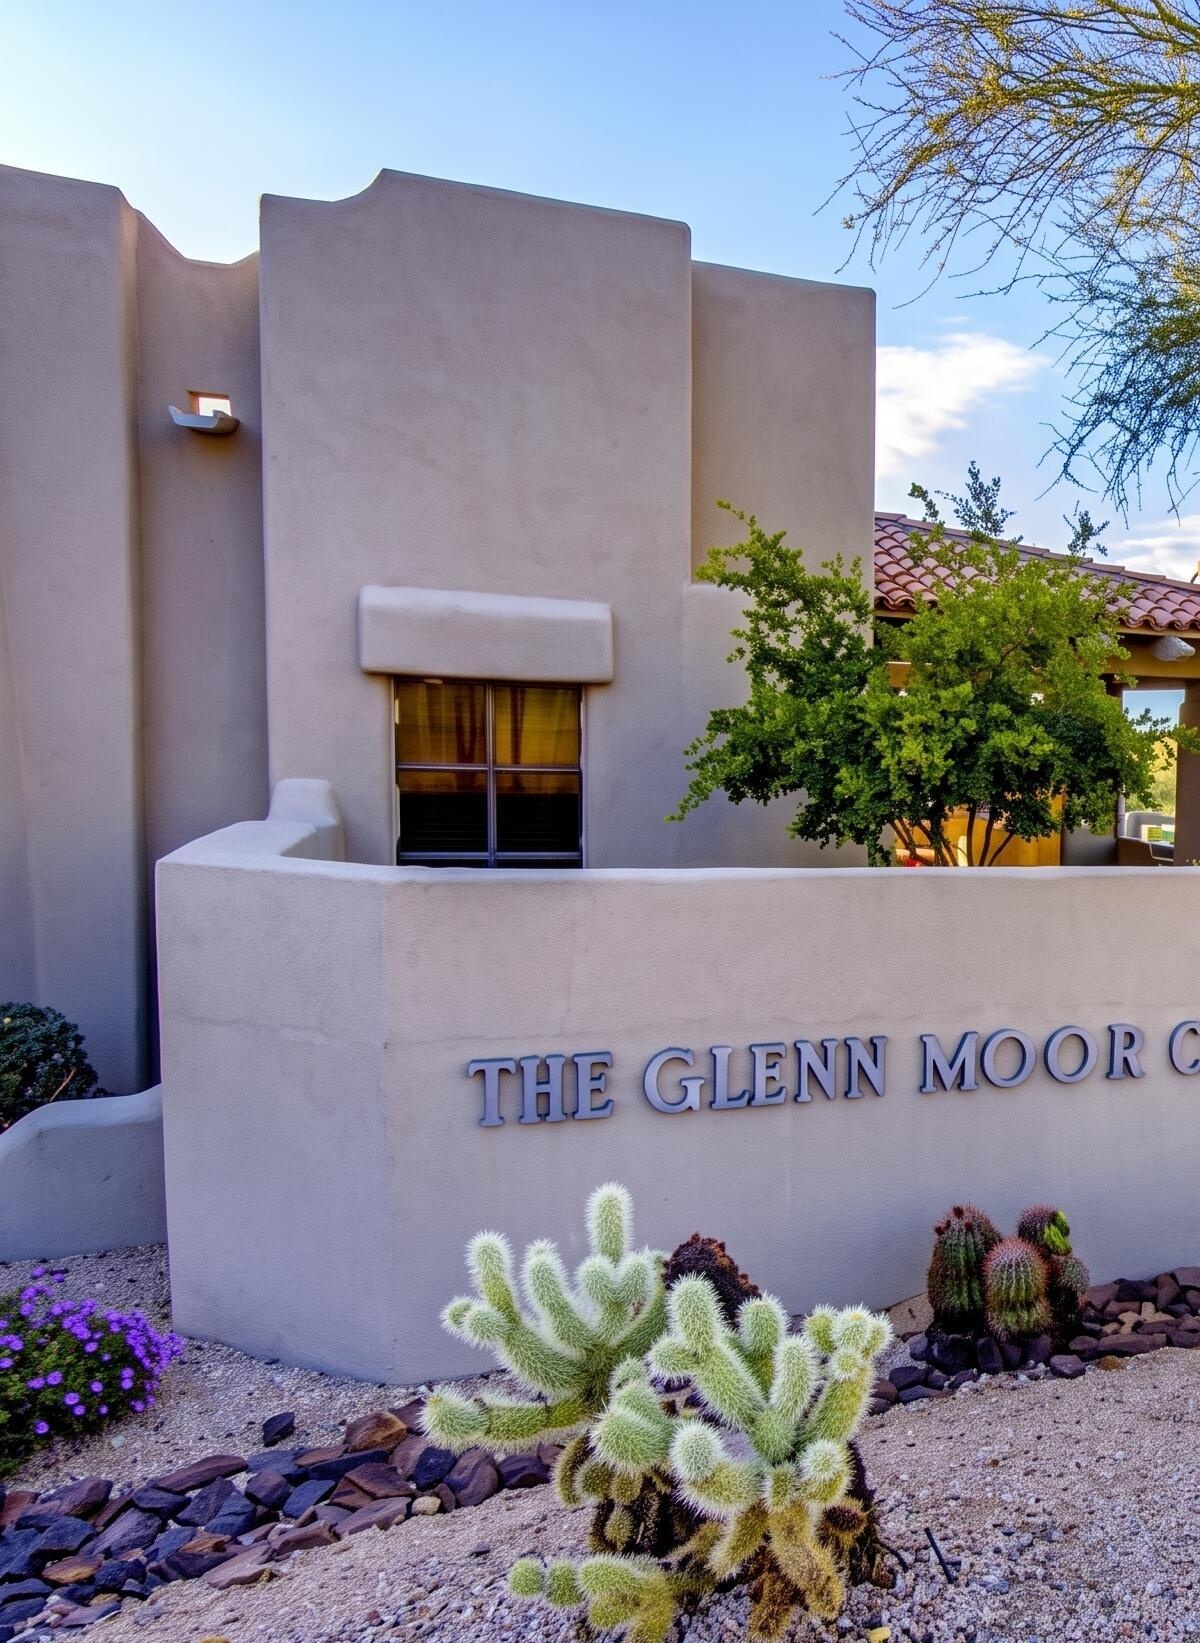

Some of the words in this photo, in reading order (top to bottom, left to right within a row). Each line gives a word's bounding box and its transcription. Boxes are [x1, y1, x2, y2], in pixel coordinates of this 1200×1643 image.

[467, 1051, 615, 1127] THE
[642, 1035, 888, 1114] GLENN
[919, 1023, 1145, 1093] MOOR
